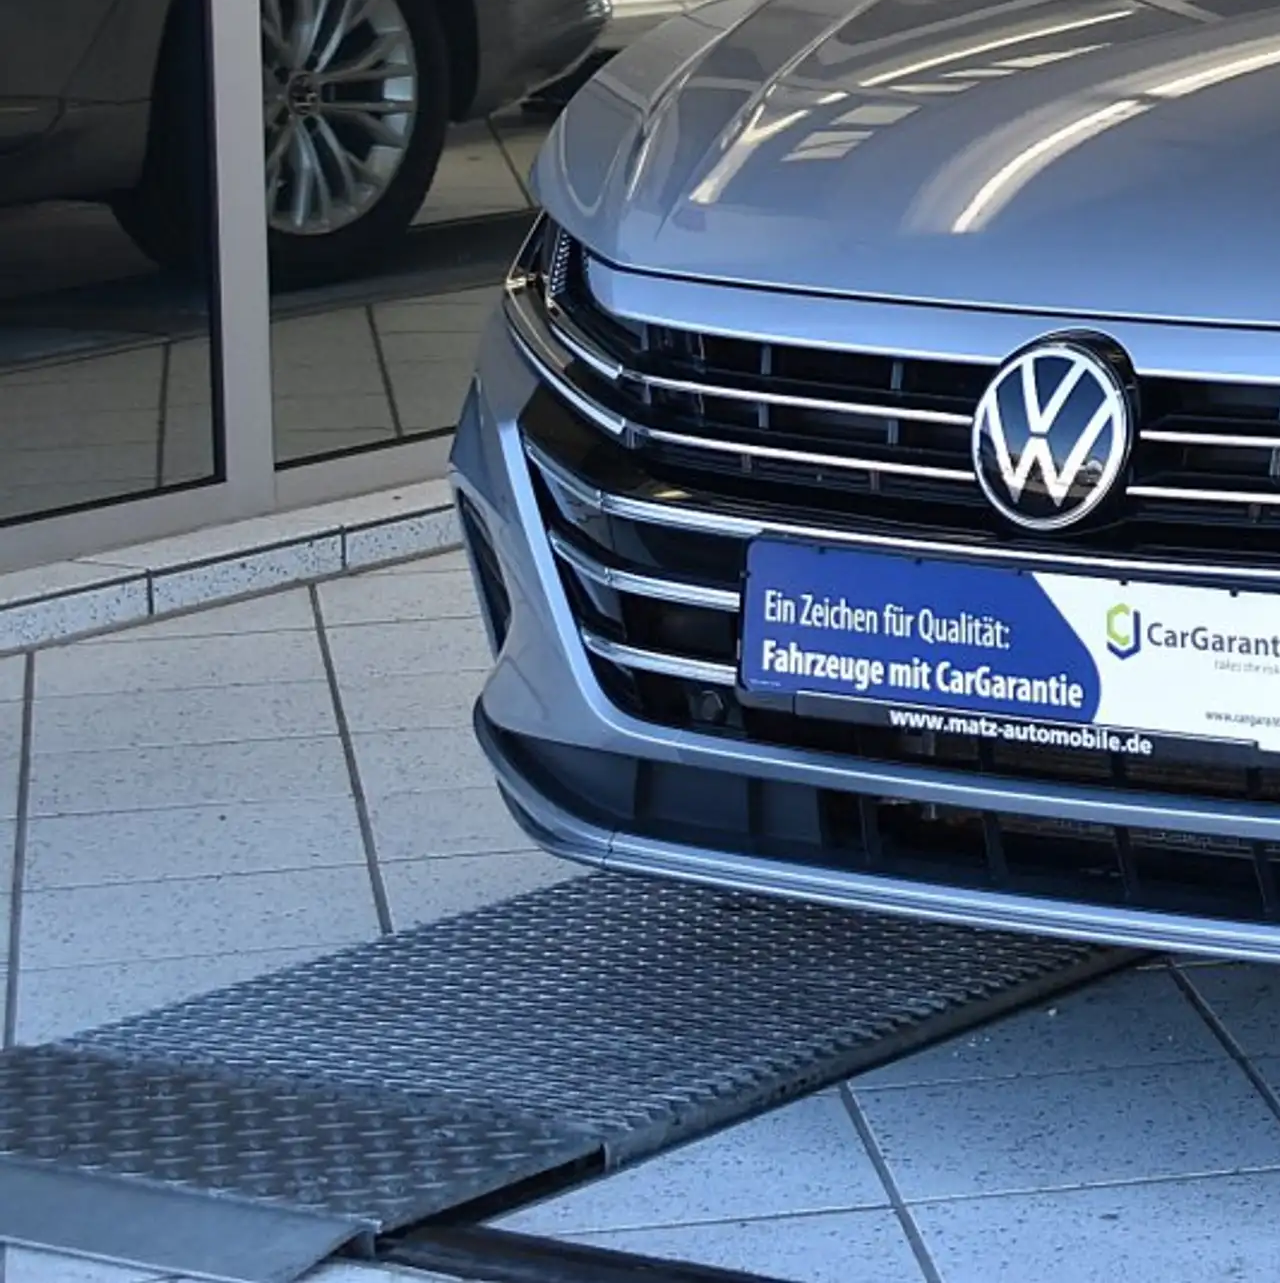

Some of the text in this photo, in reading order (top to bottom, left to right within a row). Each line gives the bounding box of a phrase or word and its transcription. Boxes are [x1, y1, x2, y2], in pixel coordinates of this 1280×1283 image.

[978, 350, 1121, 515] VW
[764, 589, 1011, 650] Ein Zeichen für Qualität:
[762, 640, 1085, 708] Fahrzeuge mit CarGarantie
[889, 708, 1153, 754] www.matz-automobile.de
